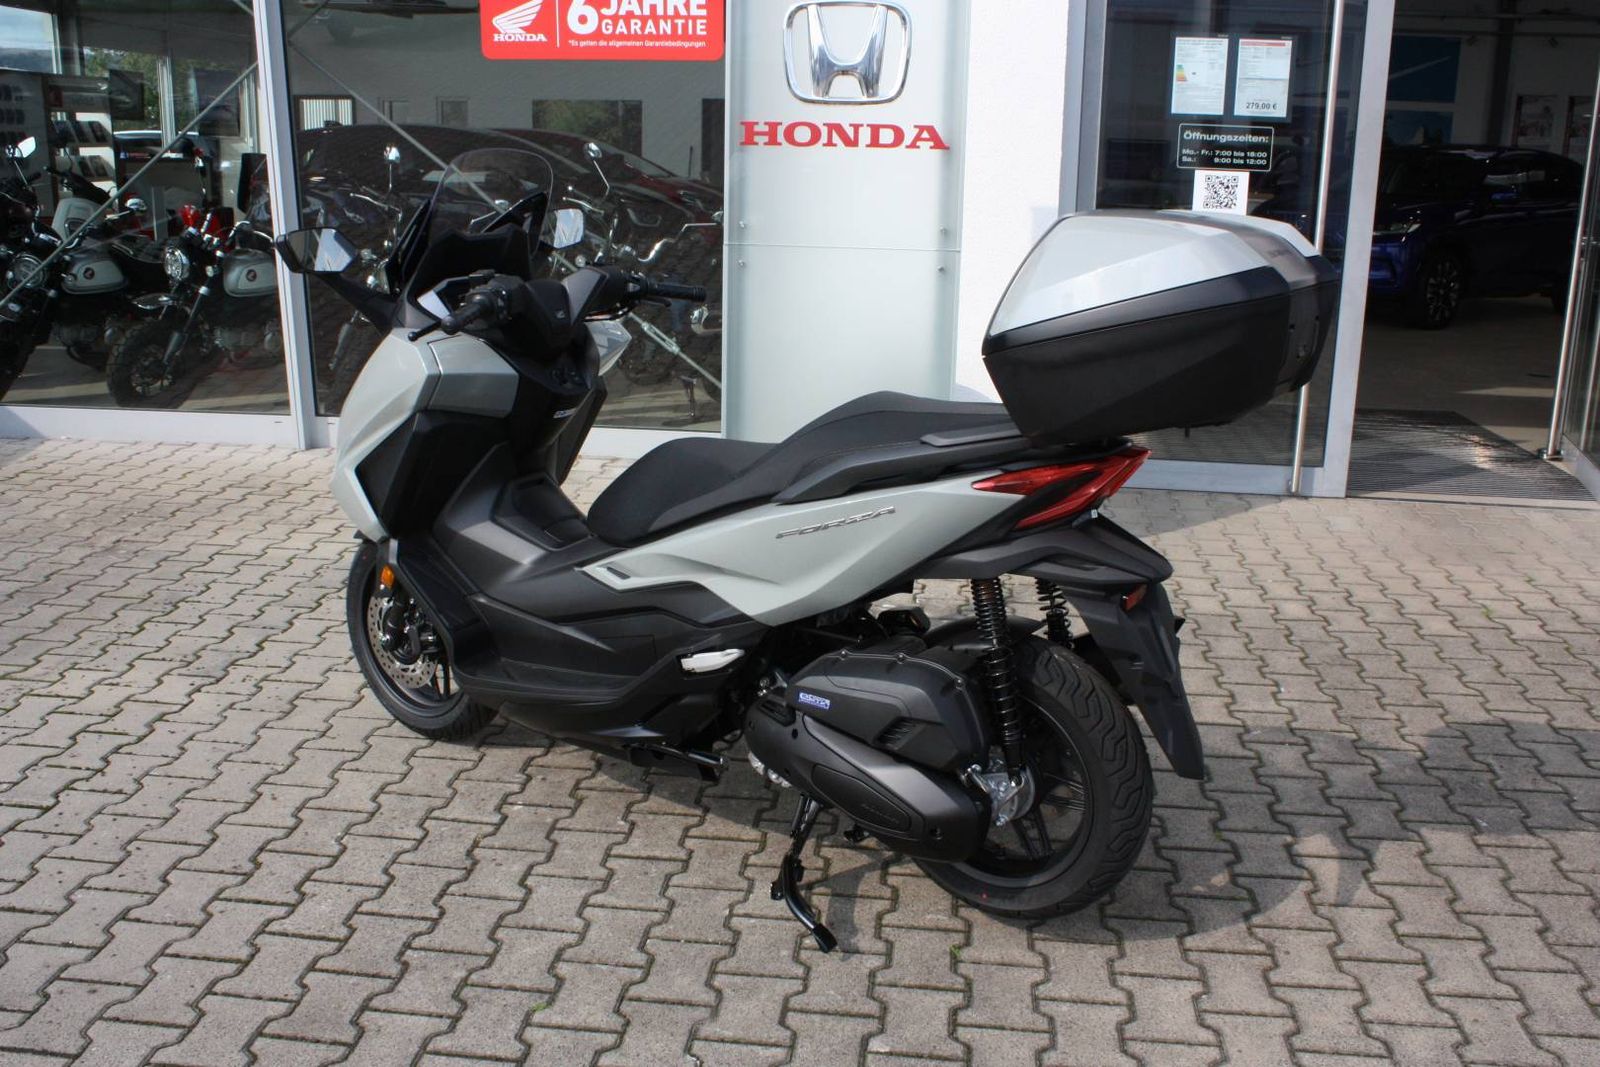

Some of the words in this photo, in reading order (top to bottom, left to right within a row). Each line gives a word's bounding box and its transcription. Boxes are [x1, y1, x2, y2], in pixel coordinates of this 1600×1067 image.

[567, 0, 599, 35] 6
[600, 0, 708, 16] JAHRE
[601, 18, 708, 35] GARANTIE
[493, 33, 548, 42] HONDA
[739, 121, 950, 150] HONDA
[1183, 130, 1269, 143] Öffnungszeiten:
